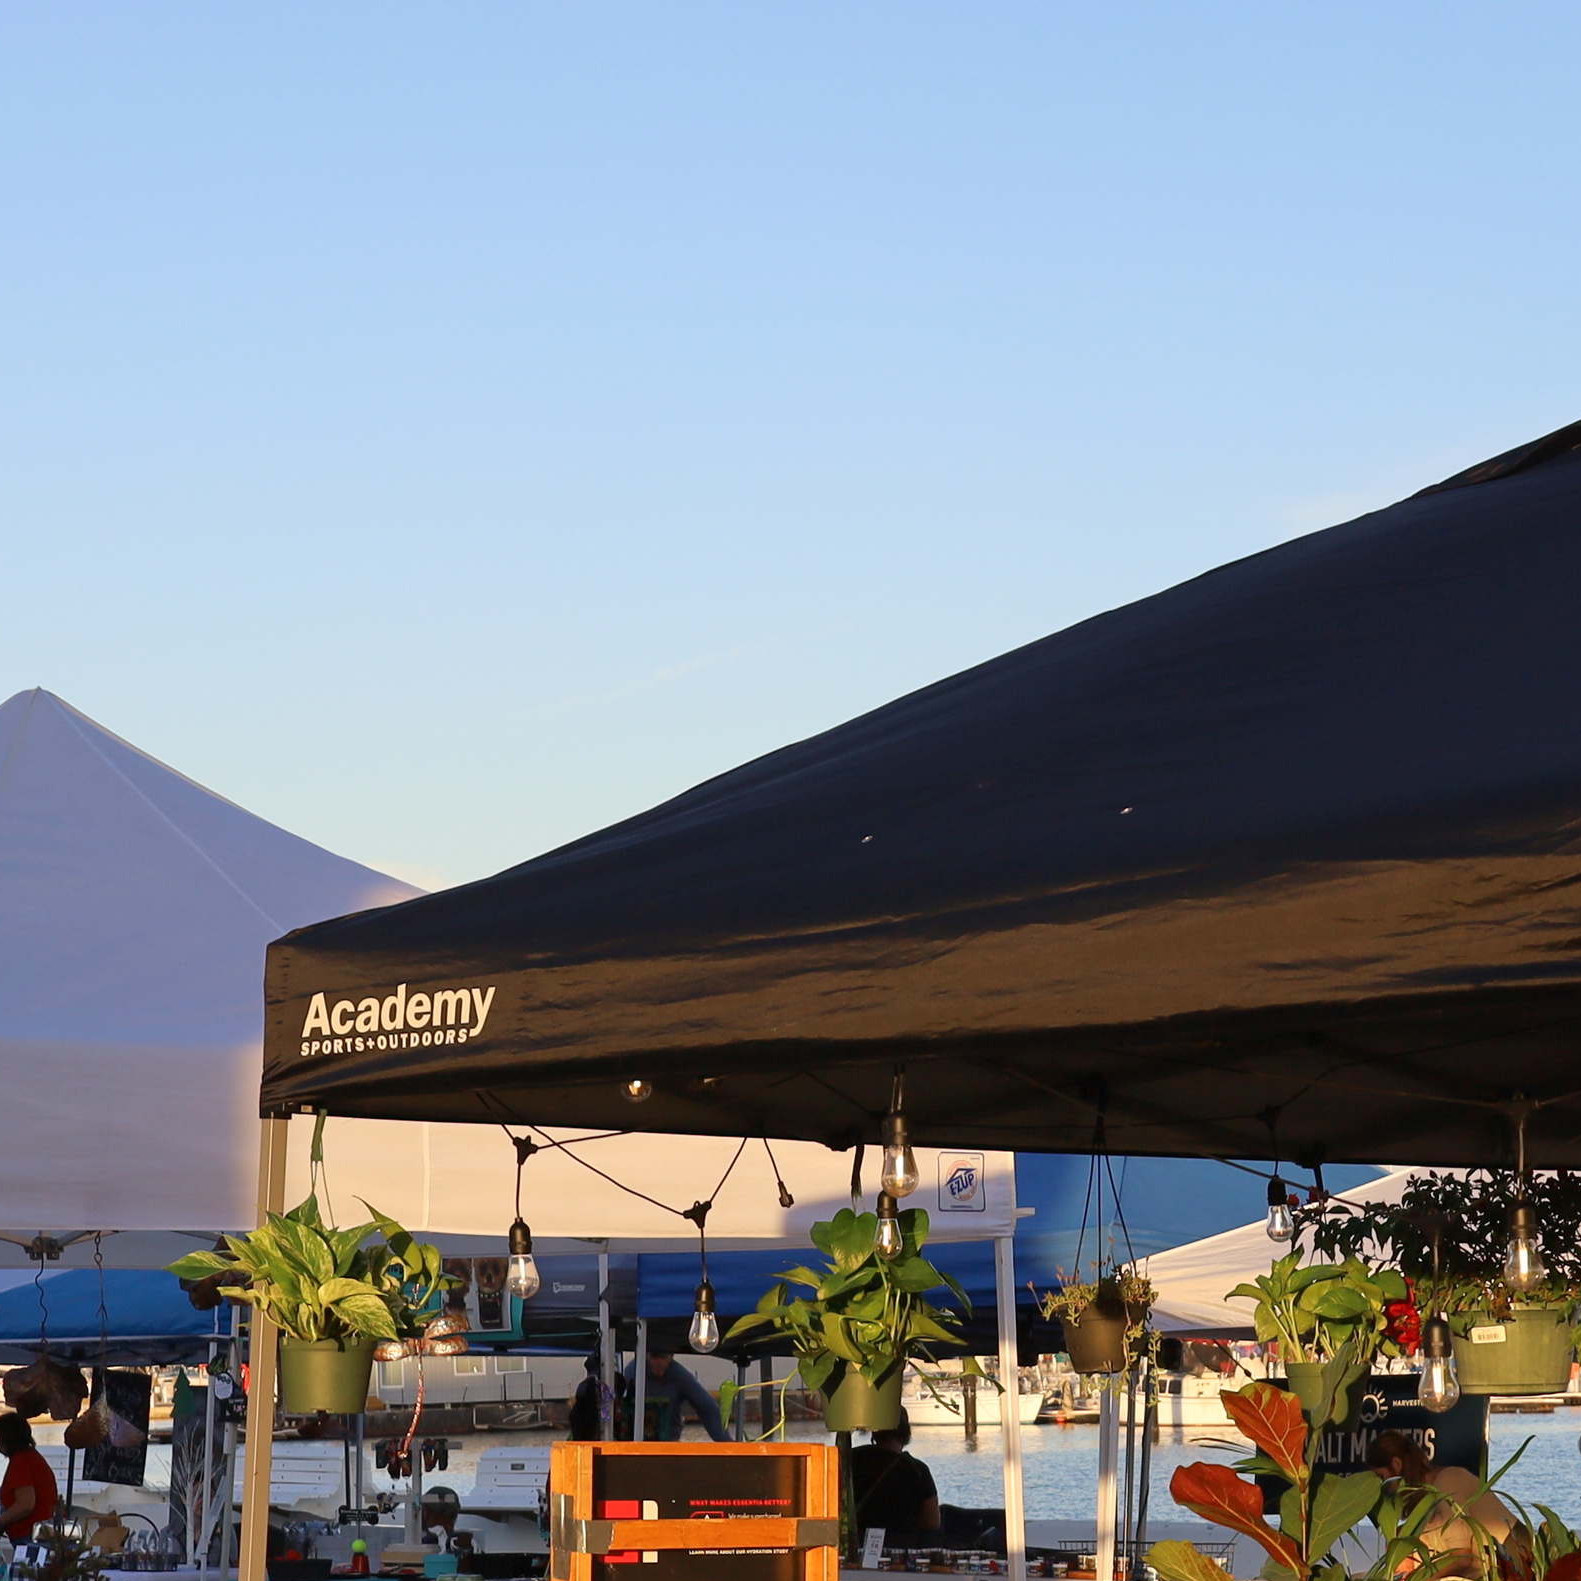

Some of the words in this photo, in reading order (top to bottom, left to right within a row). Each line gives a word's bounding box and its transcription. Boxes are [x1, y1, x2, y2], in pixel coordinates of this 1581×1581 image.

[301, 983, 496, 1037] Academy
[300, 1028, 468, 1056] SPORTS+OUTDOORS
[1305, 1431, 1345, 1463] ALT
